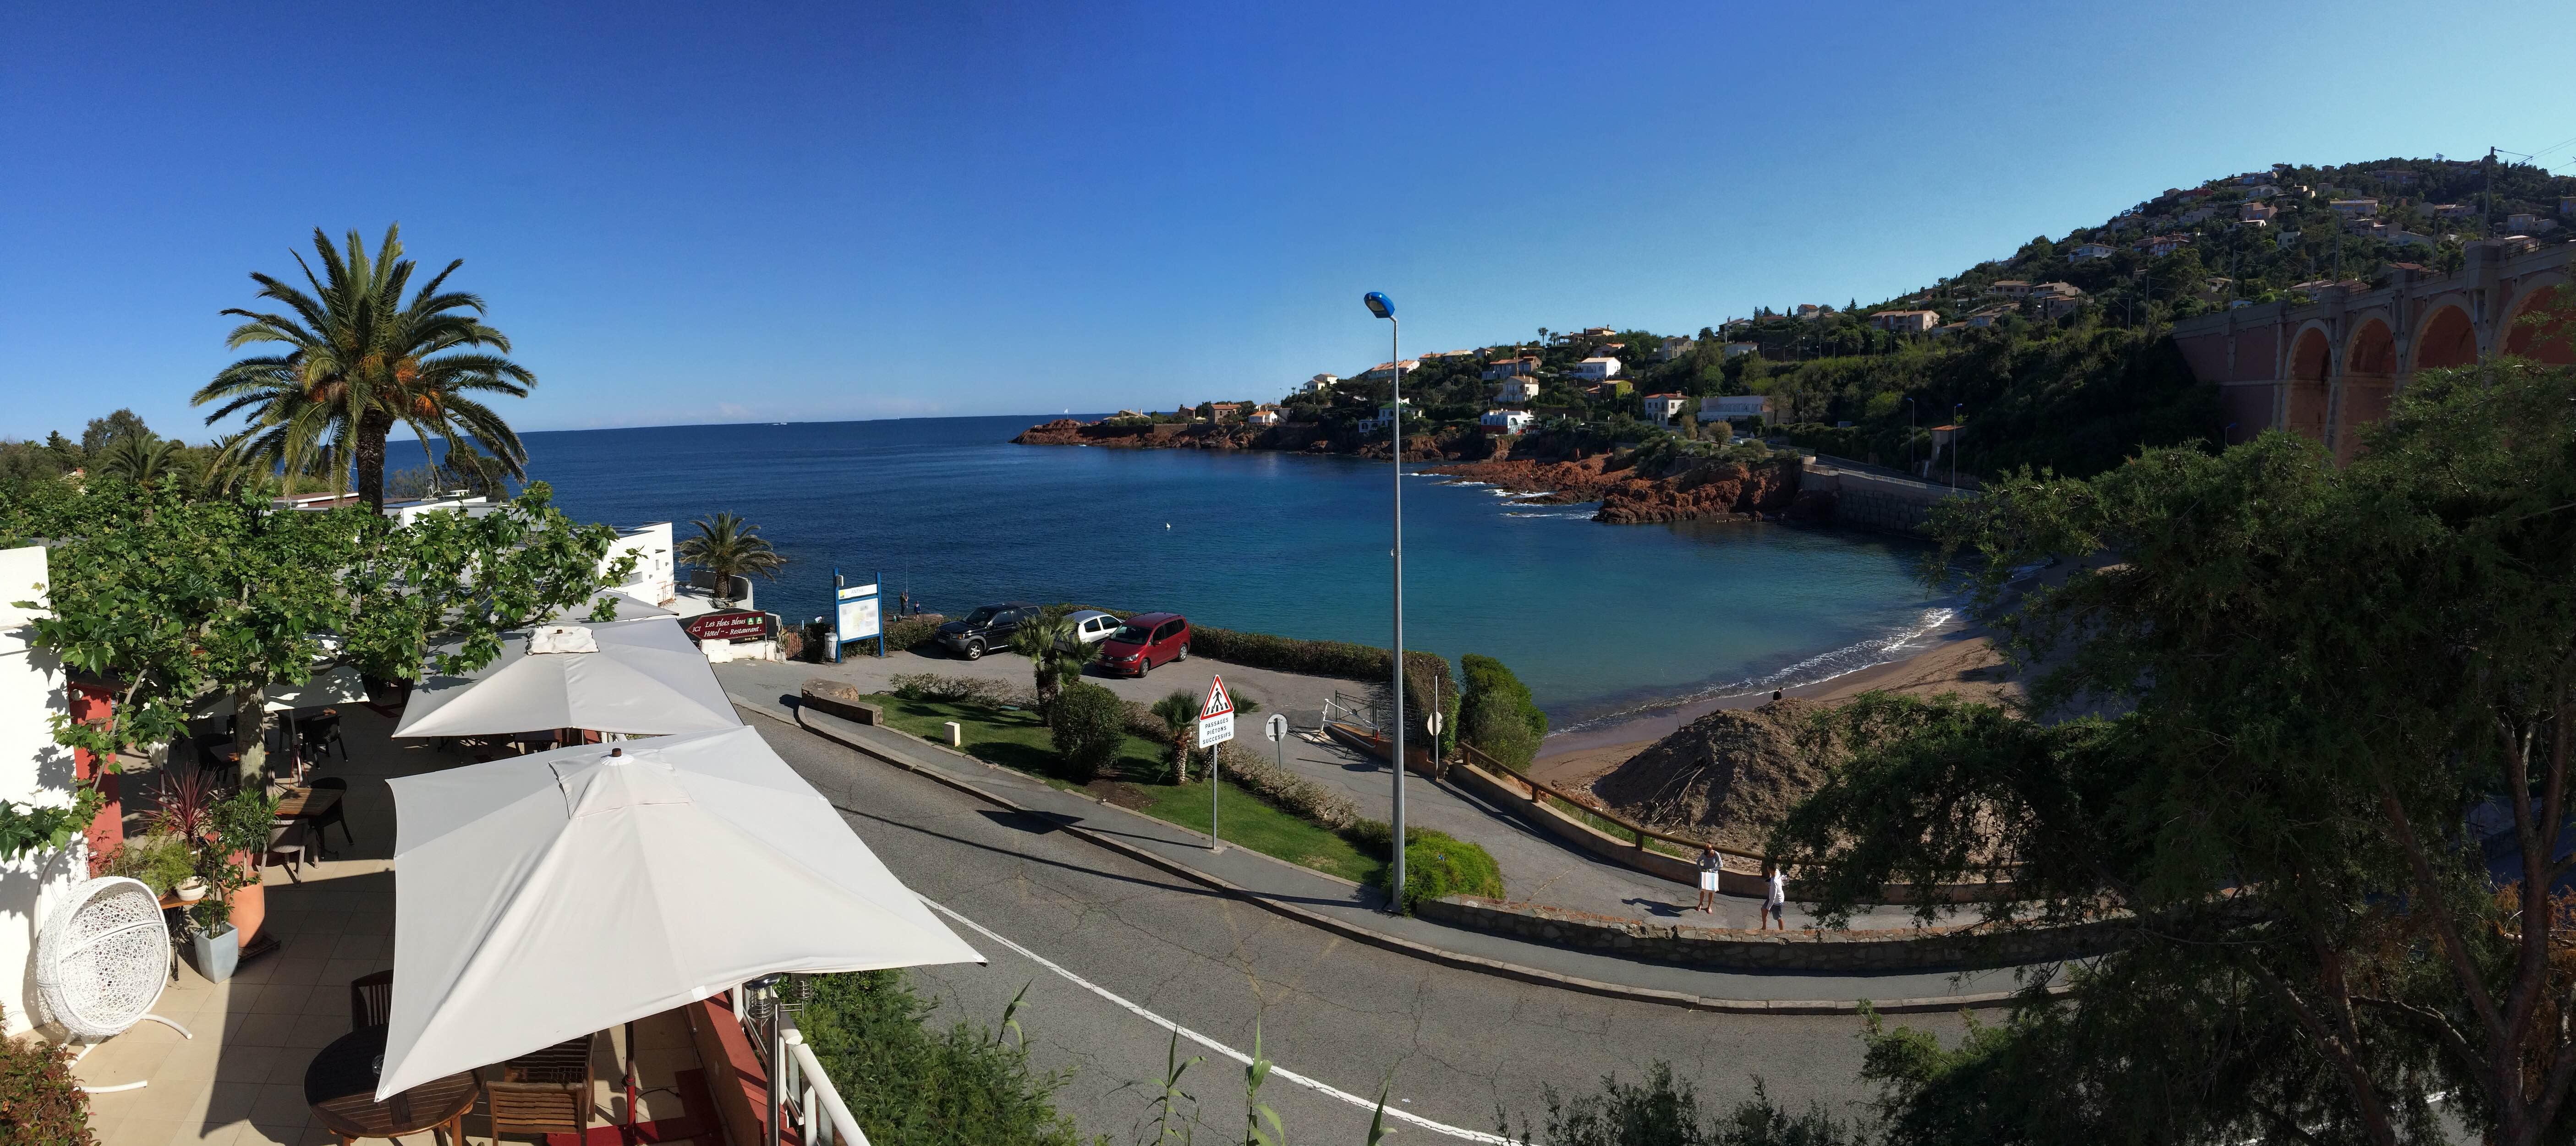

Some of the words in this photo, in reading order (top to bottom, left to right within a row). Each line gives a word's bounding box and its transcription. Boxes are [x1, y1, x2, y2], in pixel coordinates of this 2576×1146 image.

[716, 618, 729, 627] Flots
[731, 617, 746, 626] Bleus
[704, 628, 720, 637] Hôtel
[1205, 718, 1228, 729] PASSAGES
[1207, 726, 1227, 736] PIÉTONS
[1203, 731, 1231, 744] SUCCESSIFS
